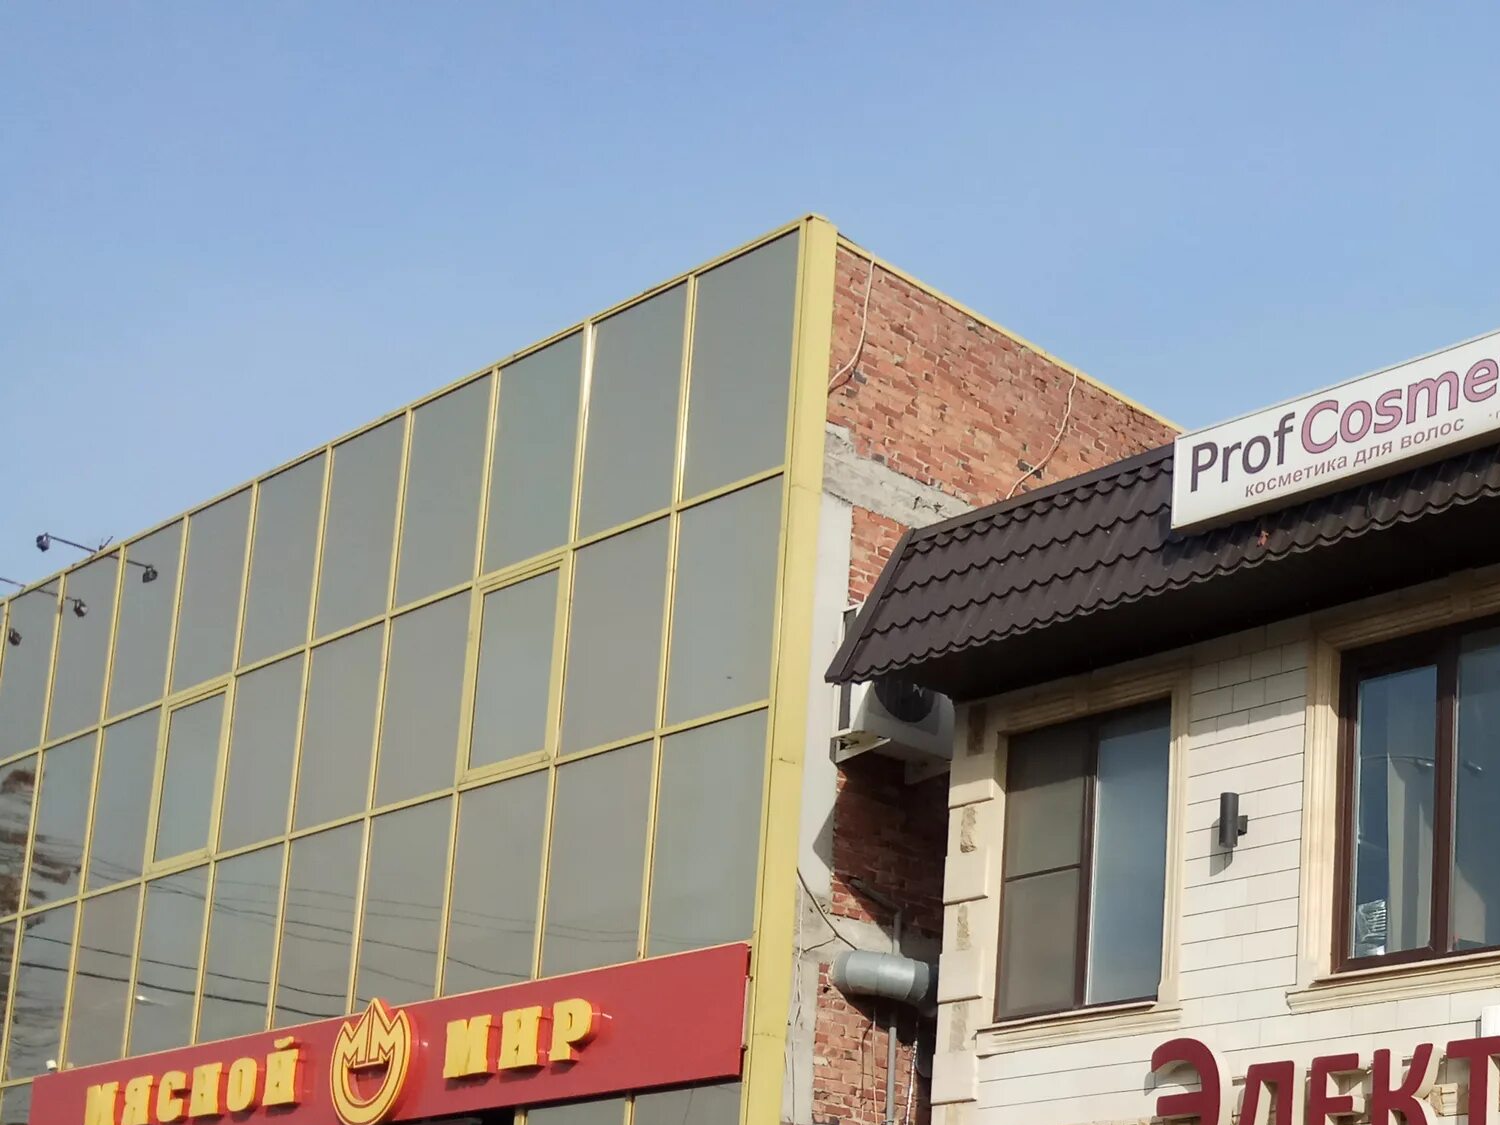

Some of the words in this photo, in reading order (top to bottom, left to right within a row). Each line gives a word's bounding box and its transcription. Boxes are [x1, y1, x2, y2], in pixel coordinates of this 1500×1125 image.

[1190, 412, 1296, 492] Prof
[1245, 456, 1348, 498] косметика
[1353, 440, 1393, 467] для
[1400, 418, 1464, 449] волос
[443, 997, 596, 1079] МИР
